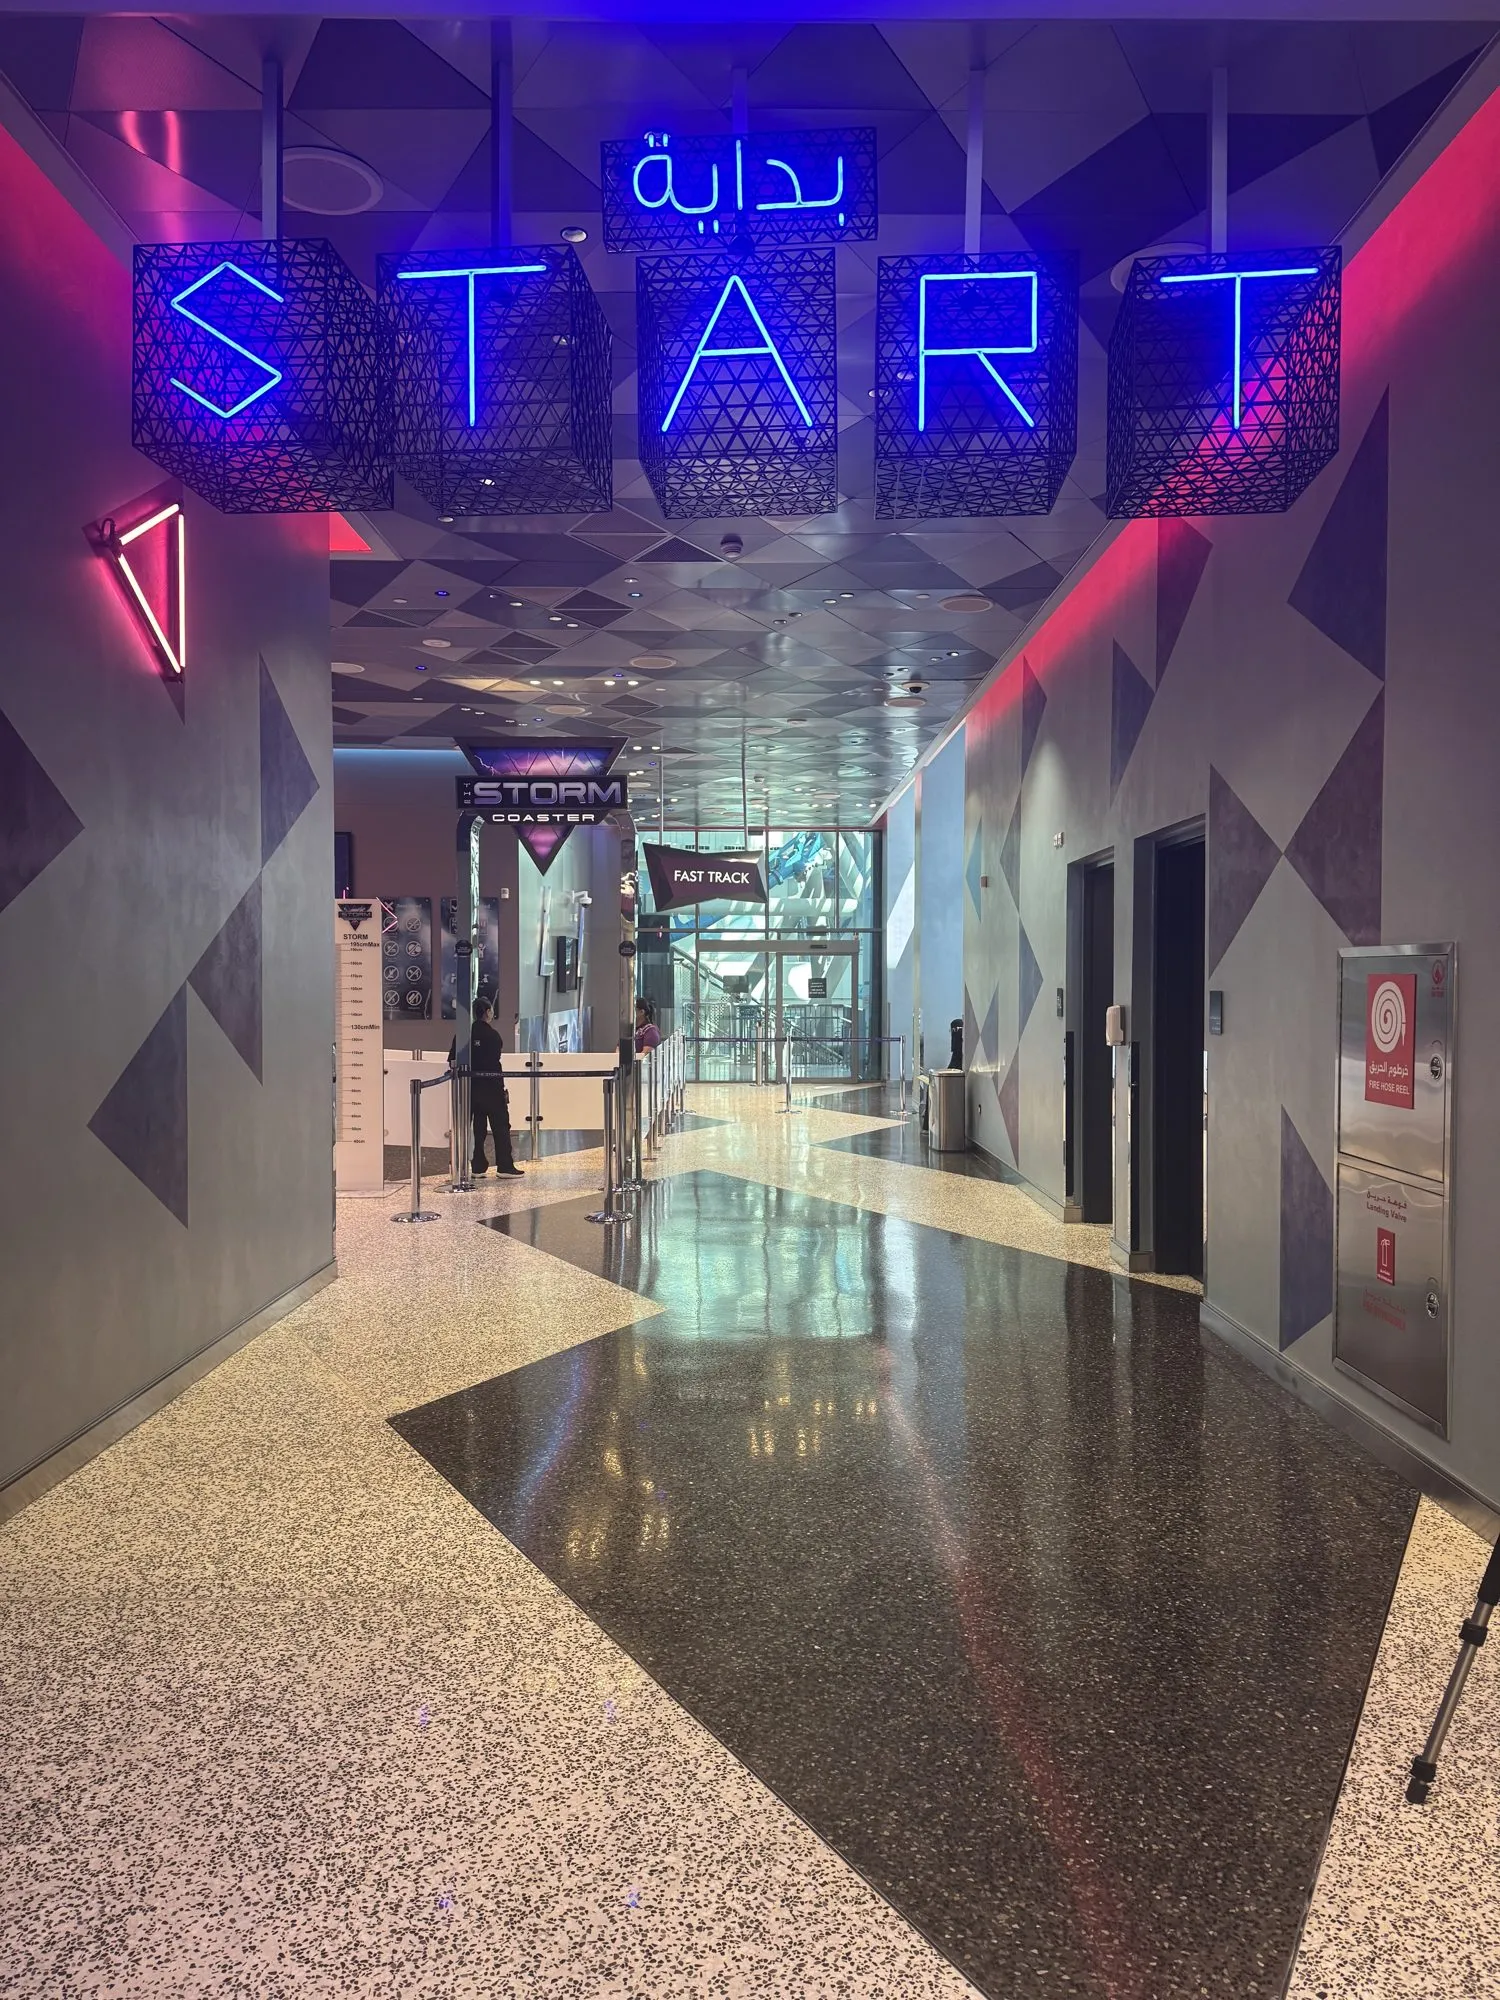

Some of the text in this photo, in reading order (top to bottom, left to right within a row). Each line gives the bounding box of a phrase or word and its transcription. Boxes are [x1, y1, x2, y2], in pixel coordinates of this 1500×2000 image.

[633, 131, 846, 235] بداية
[169, 261, 1320, 433] START
[473, 781, 622, 805] STORM
[492, 813, 595, 822] COASTER
[673, 869, 750, 885] FAST TRACK
[1369, 1061, 1409, 1078] خرطوم الحريق
[1369, 1080, 1410, 1095] FIRE HOSE REEL
[1366, 1200, 1407, 1223] Landing Valve
